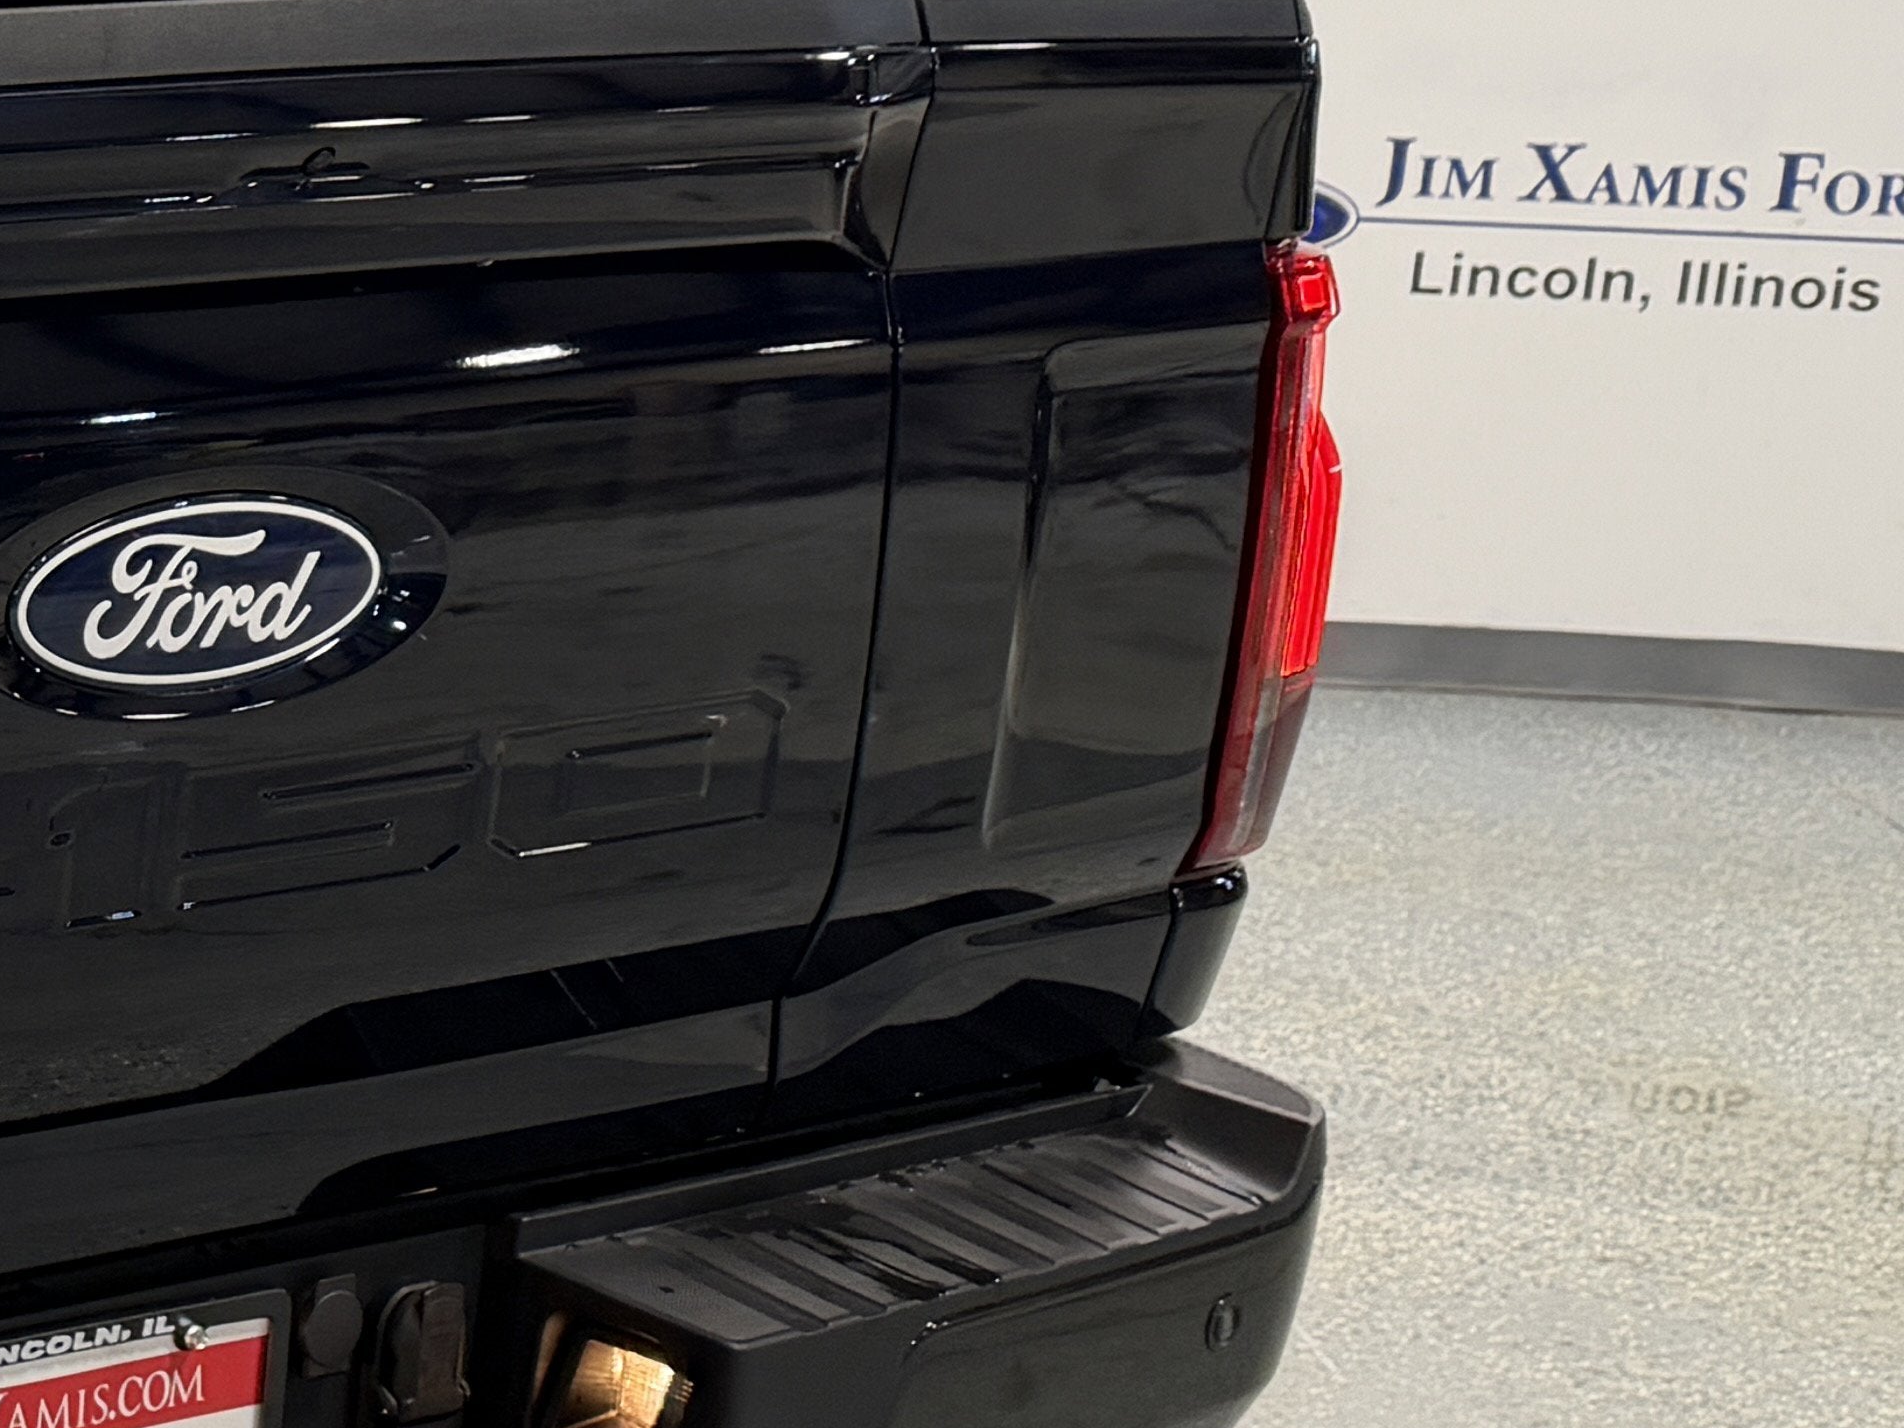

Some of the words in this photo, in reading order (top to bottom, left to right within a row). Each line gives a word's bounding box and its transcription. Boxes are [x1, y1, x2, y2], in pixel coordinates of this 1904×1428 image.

[1376, 136, 1499, 208] JIM
[1517, 141, 1748, 211] XAMIS
[1768, 151, 1904, 217] FOR
[1408, 250, 1652, 313] Lincoln,
[1675, 260, 1882, 313] Illinois
[83, 528, 322, 660] Ford
[141, 1314, 177, 1339] IL
